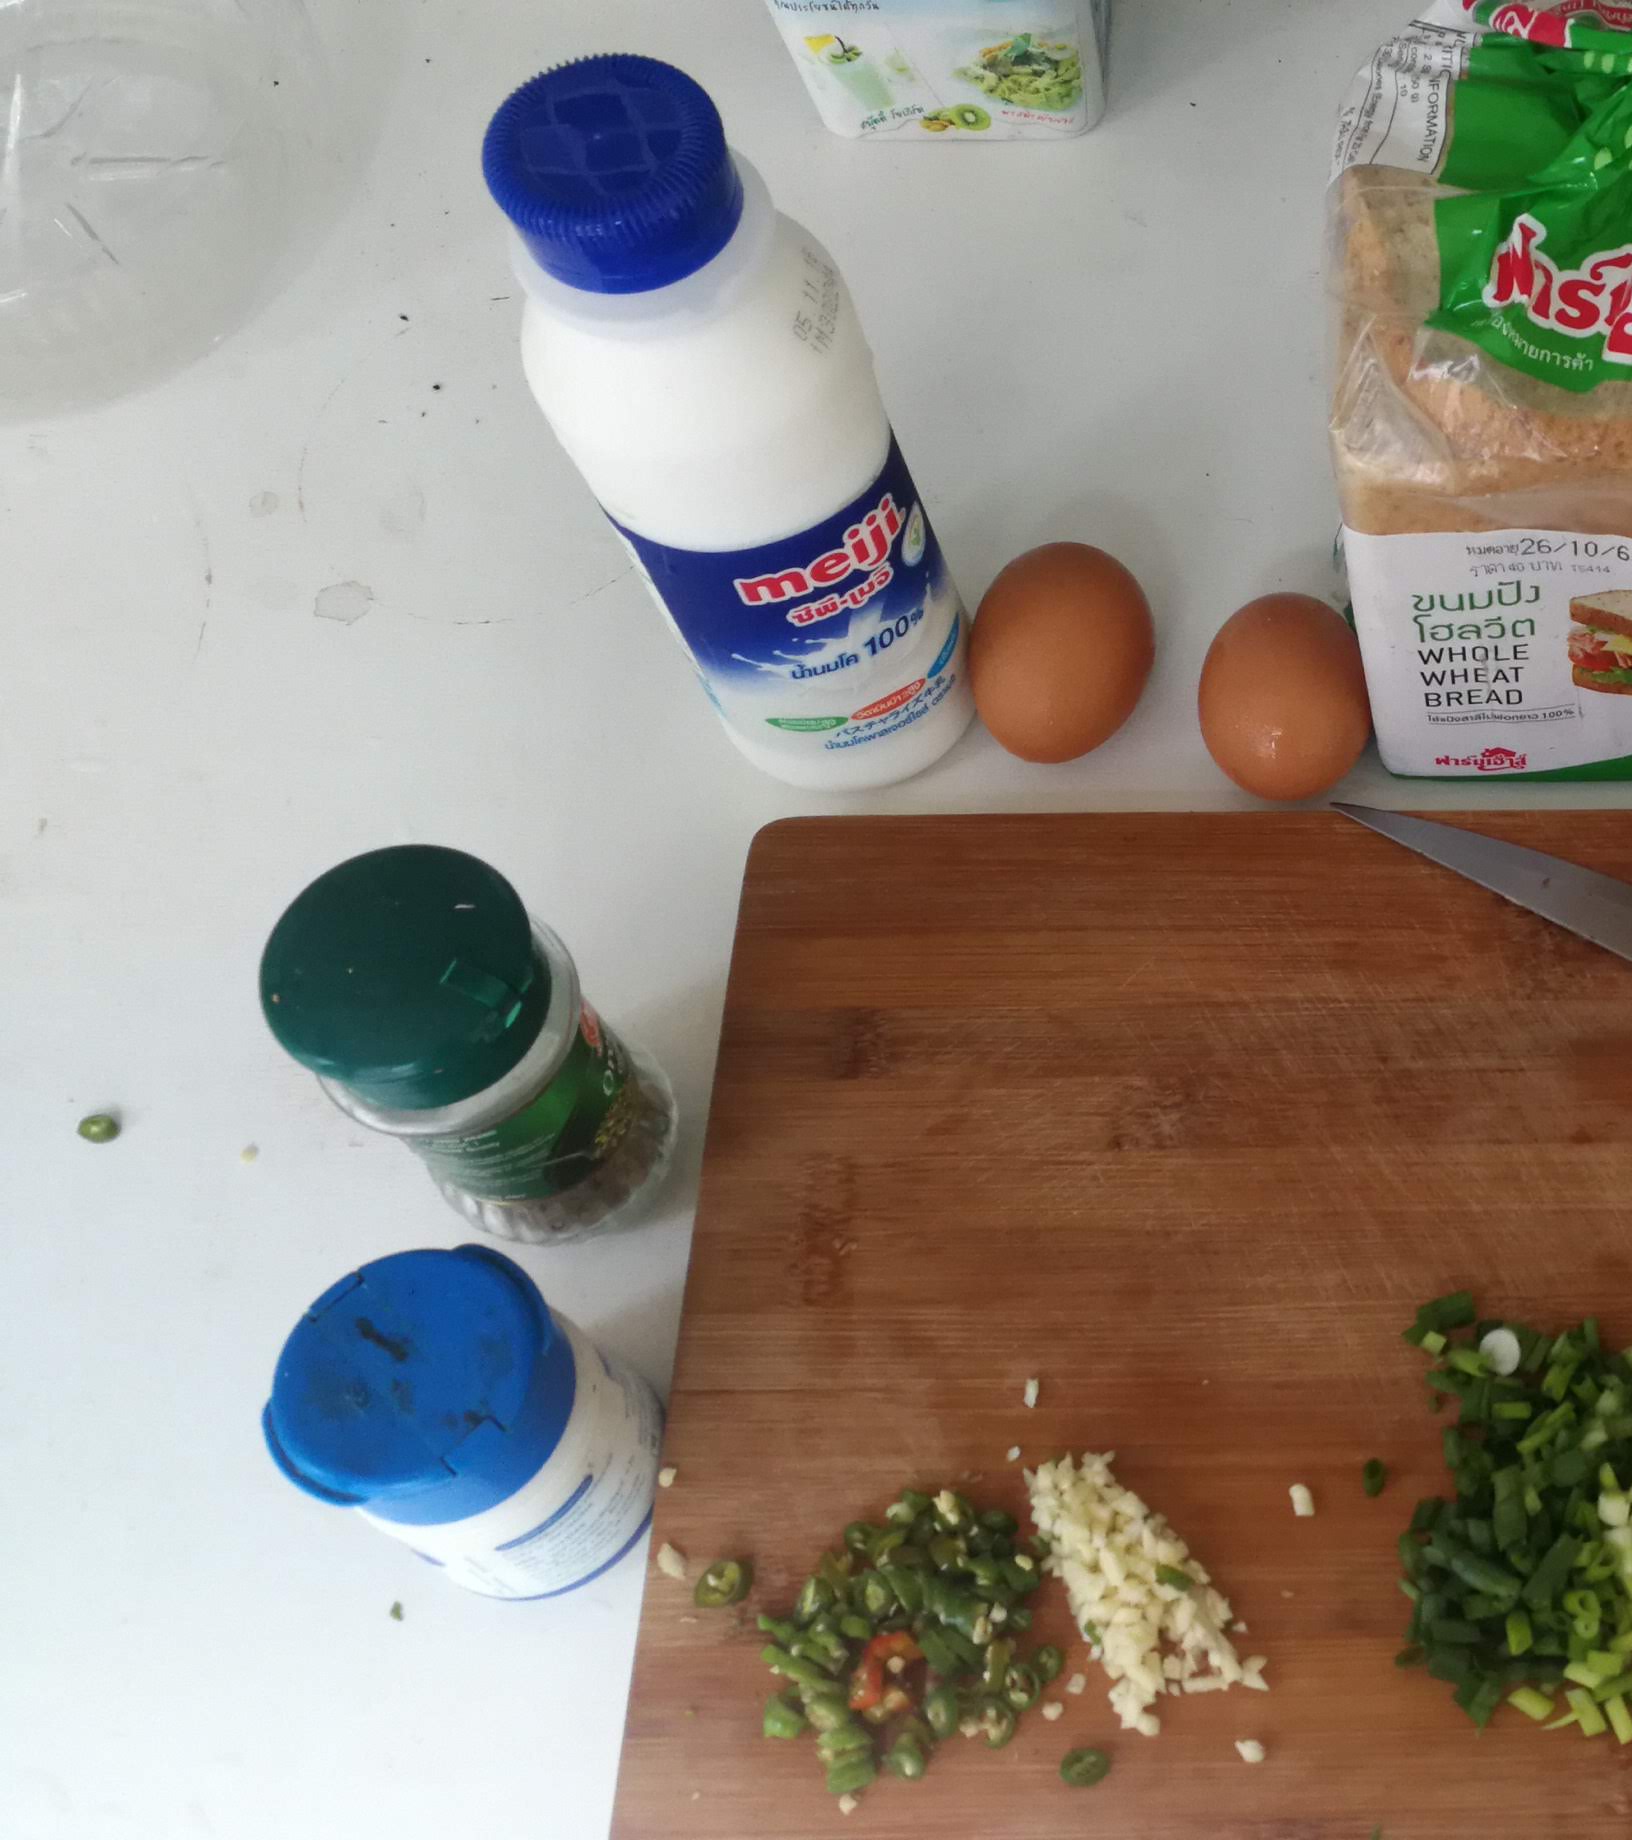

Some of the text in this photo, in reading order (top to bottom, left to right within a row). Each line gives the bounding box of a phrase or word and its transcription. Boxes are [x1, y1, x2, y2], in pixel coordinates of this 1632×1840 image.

[733, 493, 904, 606] meiji
[1411, 578, 1541, 613] ขนมปัง
[864, 605, 927, 657] 100%
[1417, 642, 1530, 667] WHOLE
[1419, 667, 1524, 689] WHEAT
[1423, 688, 1523, 708] BREAD
[1542, 708, 1576, 720] 100%
